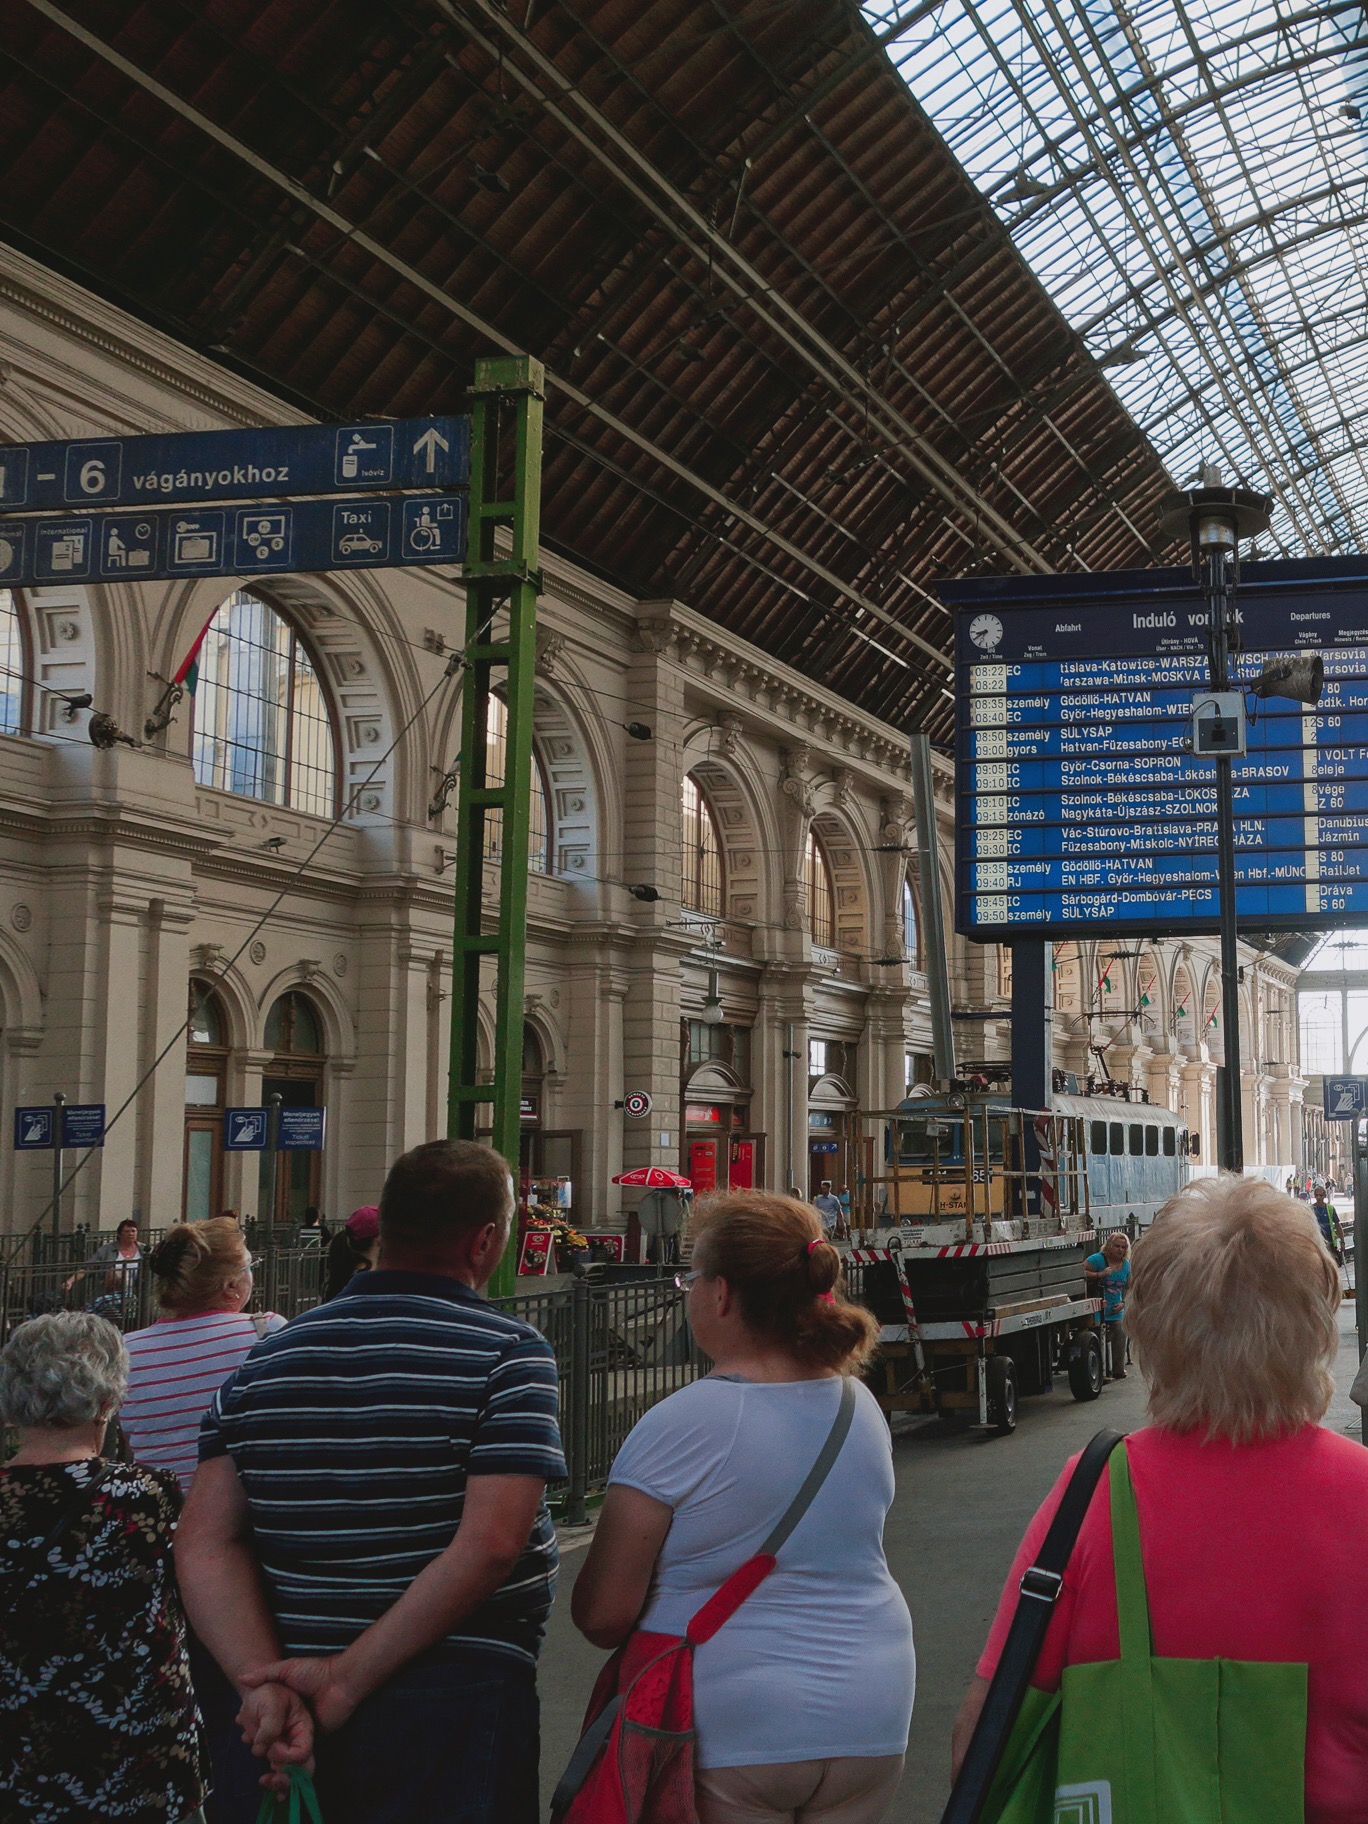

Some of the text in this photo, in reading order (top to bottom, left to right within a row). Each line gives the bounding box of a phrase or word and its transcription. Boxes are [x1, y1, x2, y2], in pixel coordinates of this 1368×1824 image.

[80, 460, 289, 493] 6 vágányokhoz
[341, 511, 371, 524] Taxi
[40, 527, 87, 535] International
[1055, 611, 1331, 632] Abfahrt Induló Departures
[975, 667, 1004, 676] 08:22
[1007, 665, 1021, 676] EC
[975, 680, 1004, 690] 08:22
[975, 692, 1150, 710] 08:35 személy Gödöllő-HATVAN
[975, 712, 1021, 722] 08:40 EC
[976, 732, 1003, 742] 08:50
[1007, 730, 1050, 741] személy
[1304, 718, 1316, 728] 12
[1328, 717, 1341, 727] 60
[976, 744, 1037, 756] 09:00 gyors
[976, 765, 1004, 775] 09:05
[1007, 764, 1020, 773] IC
[1061, 758, 1181, 772] Győr-Csorna-SOPRON
[1325, 750, 1355, 760] VOLT
[976, 765, 1344, 789] 09:10 IC eleje
[977, 784, 1344, 807] 09:10 IC vége
[977, 798, 1343, 821] 09:15 zónázó Nagykáta-Újszász-SZOLNOK 60
[977, 831, 1004, 841] 09:25
[1008, 830, 1022, 840] EC
[1241, 821, 1264, 831] HLN.
[977, 831, 1359, 854] 09:30 IC Jázmin
[977, 852, 1344, 874] 09:35 személy Gödöllő-HATVAN 80
[977, 865, 1360, 888] 09:40 RJ EN HBF. RailJet
[976, 886, 1353, 907] 09:45 IC Sárbogárd-Dombóvár-PÉCS Dráva
[977, 911, 1005, 921] 09:50
[1008, 909, 1051, 921] személy
[1332, 899, 1345, 909] 60
